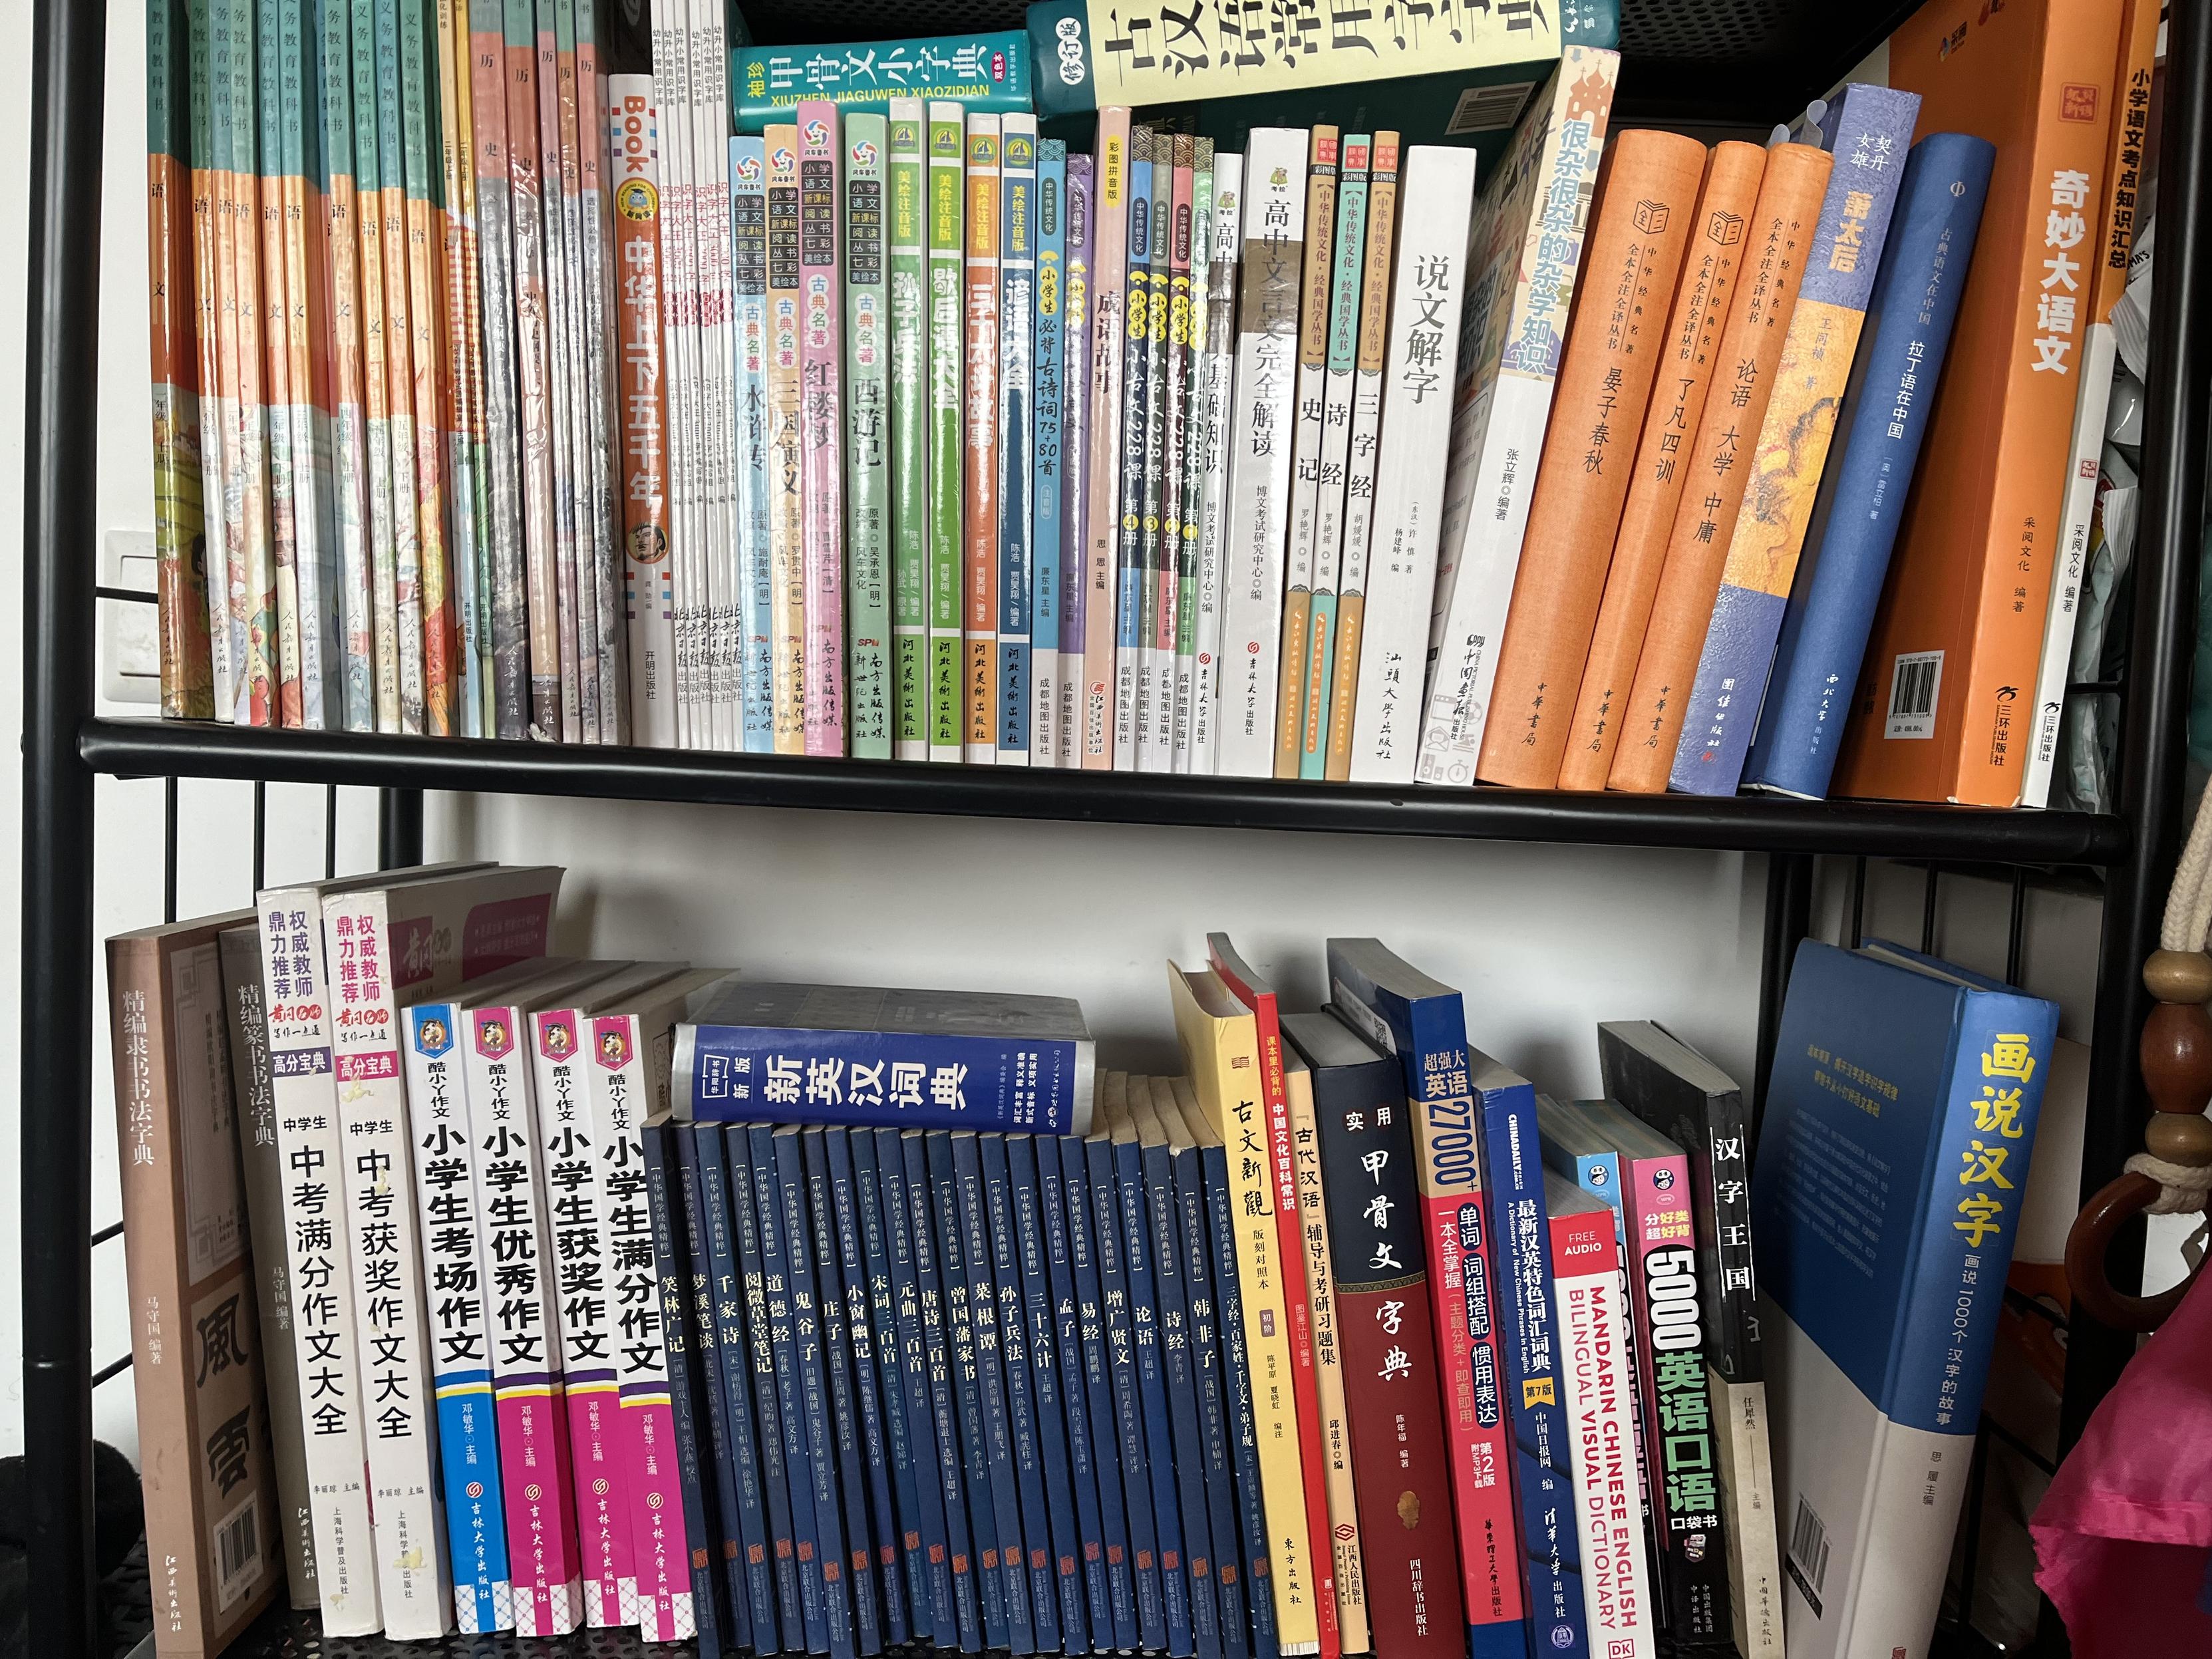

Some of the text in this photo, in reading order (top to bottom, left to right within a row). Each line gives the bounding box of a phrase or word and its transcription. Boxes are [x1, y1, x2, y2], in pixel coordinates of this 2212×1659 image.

[653, 29, 665, 106] 幼升小常用识字库
[714, 25, 724, 106] 幼升小常用识字库
[748, 62, 765, 97] 袖珍
[769, 43, 987, 90] 甲骨文小字典
[1056, 19, 1082, 84] 修订版
[772, 84, 989, 107] XIUZHEN JIAGUWEN XIAOZIDIAN
[623, 95, 650, 174] Book
[804, 162, 830, 174] 小学
[1107, 142, 1120, 200] 彩图拼音版
[1849, 132, 1877, 168] 女雄
[1869, 133, 1893, 172] 契丹
[2108, 69, 2151, 269] 小学语文考点知识汇总
[804, 178, 830, 190] 语文
[804, 192, 832, 204] 新课标
[804, 208, 832, 220] 阅读
[938, 174, 952, 241] 美绘注音版
[1044, 182, 1054, 233] 中华传统文化
[1343, 172, 1367, 182] 彩图版
[804, 252, 832, 265] 美绘本
[805, 223, 832, 235] 丛书
[805, 237, 832, 249] 七彩
[1516, 118, 1593, 375] 很杂很杂的杂学知识
[1042, 269, 1056, 314] 小学生
[1605, 242, 1640, 351] 全本全注全译丛书
[1624, 246, 1658, 355] 中华经典名著
[1917, 227, 1953, 325] 古典语文在中国
[2030, 169, 2090, 375] 奇妙大语文
[811, 277, 828, 345] 古典名著
[1402, 254, 1450, 404] 说文解字
[624, 235, 662, 509] 中华上下五千年
[1887, 340, 1926, 440] 拉丁语在中国
[852, 377, 882, 467] 西游记
[1298, 398, 1322, 482] 史记
[1321, 403, 1348, 486] 诗经
[1350, 394, 1378, 499] 三字经
[1583, 367, 1624, 476] 晏子春秋
[1655, 377, 1695, 485] 了凡四训
[1692, 358, 1759, 545] 论语 大学 中庸
[1494, 448, 1519, 522] 张立辉 编著
[1250, 485, 1268, 601] 博文考试研究中心 编
[2012, 516, 2036, 613] 采阅文化 编著
[644, 651, 657, 700] 开明出版社
[1245, 658, 1257, 736] 吉林大学出版社
[1039, 678, 1050, 756] 成都地图出版社
[1993, 705, 2011, 767] 三环出版社
[268, 911, 292, 1000] 鼎力推荐
[288, 909, 315, 998] 权威教师
[237, 984, 275, 1147] 精编篆书书法字典
[272, 1052, 327, 1074] 高分宝典
[273, 1023, 321, 1039] 写作一点通
[1266, 1036, 1282, 1096] 课本里必背的
[1424, 1049, 1466, 1072] 超强大
[122, 990, 155, 1167] 精编隶书书法字典
[427, 1061, 452, 1120] 酷小丫作文
[763, 1054, 969, 1112] 新英汉词典
[1013, 1051, 1026, 1124] 词汇丰富 释义准确
[1025, 1052, 1038, 1125] 新式音标 义项实用
[1425, 1070, 1468, 1098] 英语
[283, 1115, 328, 1132] 中学生
[1271, 1102, 1297, 1211] 中国文化百科常识
[1345, 1107, 1392, 1131] 实用
[1953, 1033, 2036, 1249] 画说汉字
[422, 1124, 486, 1364] 小学生考场作文
[482, 1126, 546, 1365] 小学生优秀作文
[547, 1127, 611, 1364] 小学生获奖作文
[1437, 1210, 1462, 1289] 一本全掌握
[1565, 1242, 1603, 1257] AUDIO
[1568, 1231, 1597, 1242] FREE
[1645, 1210, 1690, 1227] 分好类
[1646, 1223, 1690, 1241] 超好背
[1715, 1137, 1750, 1291] 汉字王国
[290, 1144, 348, 1437] 中考满分作文大全
[602, 1135, 665, 1375] 小学生满分作文
[1252, 1229, 1269, 1290] 版刻对照本
[1360, 1149, 1413, 1382] 甲骨文字典
[1507, 1208, 1517, 1247] Dictionary
[1521, 1346, 1530, 1374] English
[1516, 1199, 1552, 1372] 最新汉英特色词汇词典
[357, 1148, 413, 1439] 中考获奖作文大全
[661, 1276, 685, 1354] 笑林广记
[716, 1275, 740, 1345] 千家诗
[744, 1271, 773, 1374] 阅微草堂笔记
[766, 1275, 790, 1344] 道德经
[795, 1291, 818, 1362] 鬼谷子
[824, 1300, 843, 1342] 庄子
[847, 1284, 871, 1360] 小窗幽记
[974, 1282, 997, 1351] 菜根谭
[999, 1286, 1025, 1362] 孙子兵法
[1028, 1292, 1053, 1370] 三十六计
[1080, 1302, 1100, 1342] 易经
[1106, 1290, 1131, 1367] 增广贤文
[1134, 1306, 1155, 1346] 论语
[1166, 1310, 1185, 1351] 诗经
[1262, 1313, 1273, 1334] 初阶
[1459, 1207, 1498, 1425] 单词 词组搭配 惯用表达
[1647, 1251, 1702, 1351] 5000
[921, 1290, 947, 1382] 唐诗三百首
[951, 1286, 976, 1381] 曾国藩家书
[1193, 1298, 1216, 1370] 韩非子
[1935, 1253, 1982, 1426] 画说1000个汉字的故事
[1525, 1384, 1553, 1399] 第7版
[462, 1402, 478, 1465] 邓敏华 主编
[1396, 1413, 1410, 1469] 陈年福 编著
[1480, 1441, 1496, 1487] 第2版
[1535, 1412, 1554, 1491] 中国日报网 编
[1569, 1288, 1616, 1630] BILINGUAL VISUAL DICTIONARY
[1590, 1286, 1638, 1628] MANDARIN CHINESE ENGLISH
[1655, 1351, 1717, 1513] 英语口语
[333, 1506, 350, 1596] 上海科学普及出版社
[470, 1501, 491, 1600] 吉林大学出版社
[1670, 1515, 1718, 1531] 口袋书
[1347, 1545, 1362, 1605] 江西人民出版社
[1409, 1558, 1429, 1636] 四川辞书出版社
[1611, 1642, 1631, 1658] DK
